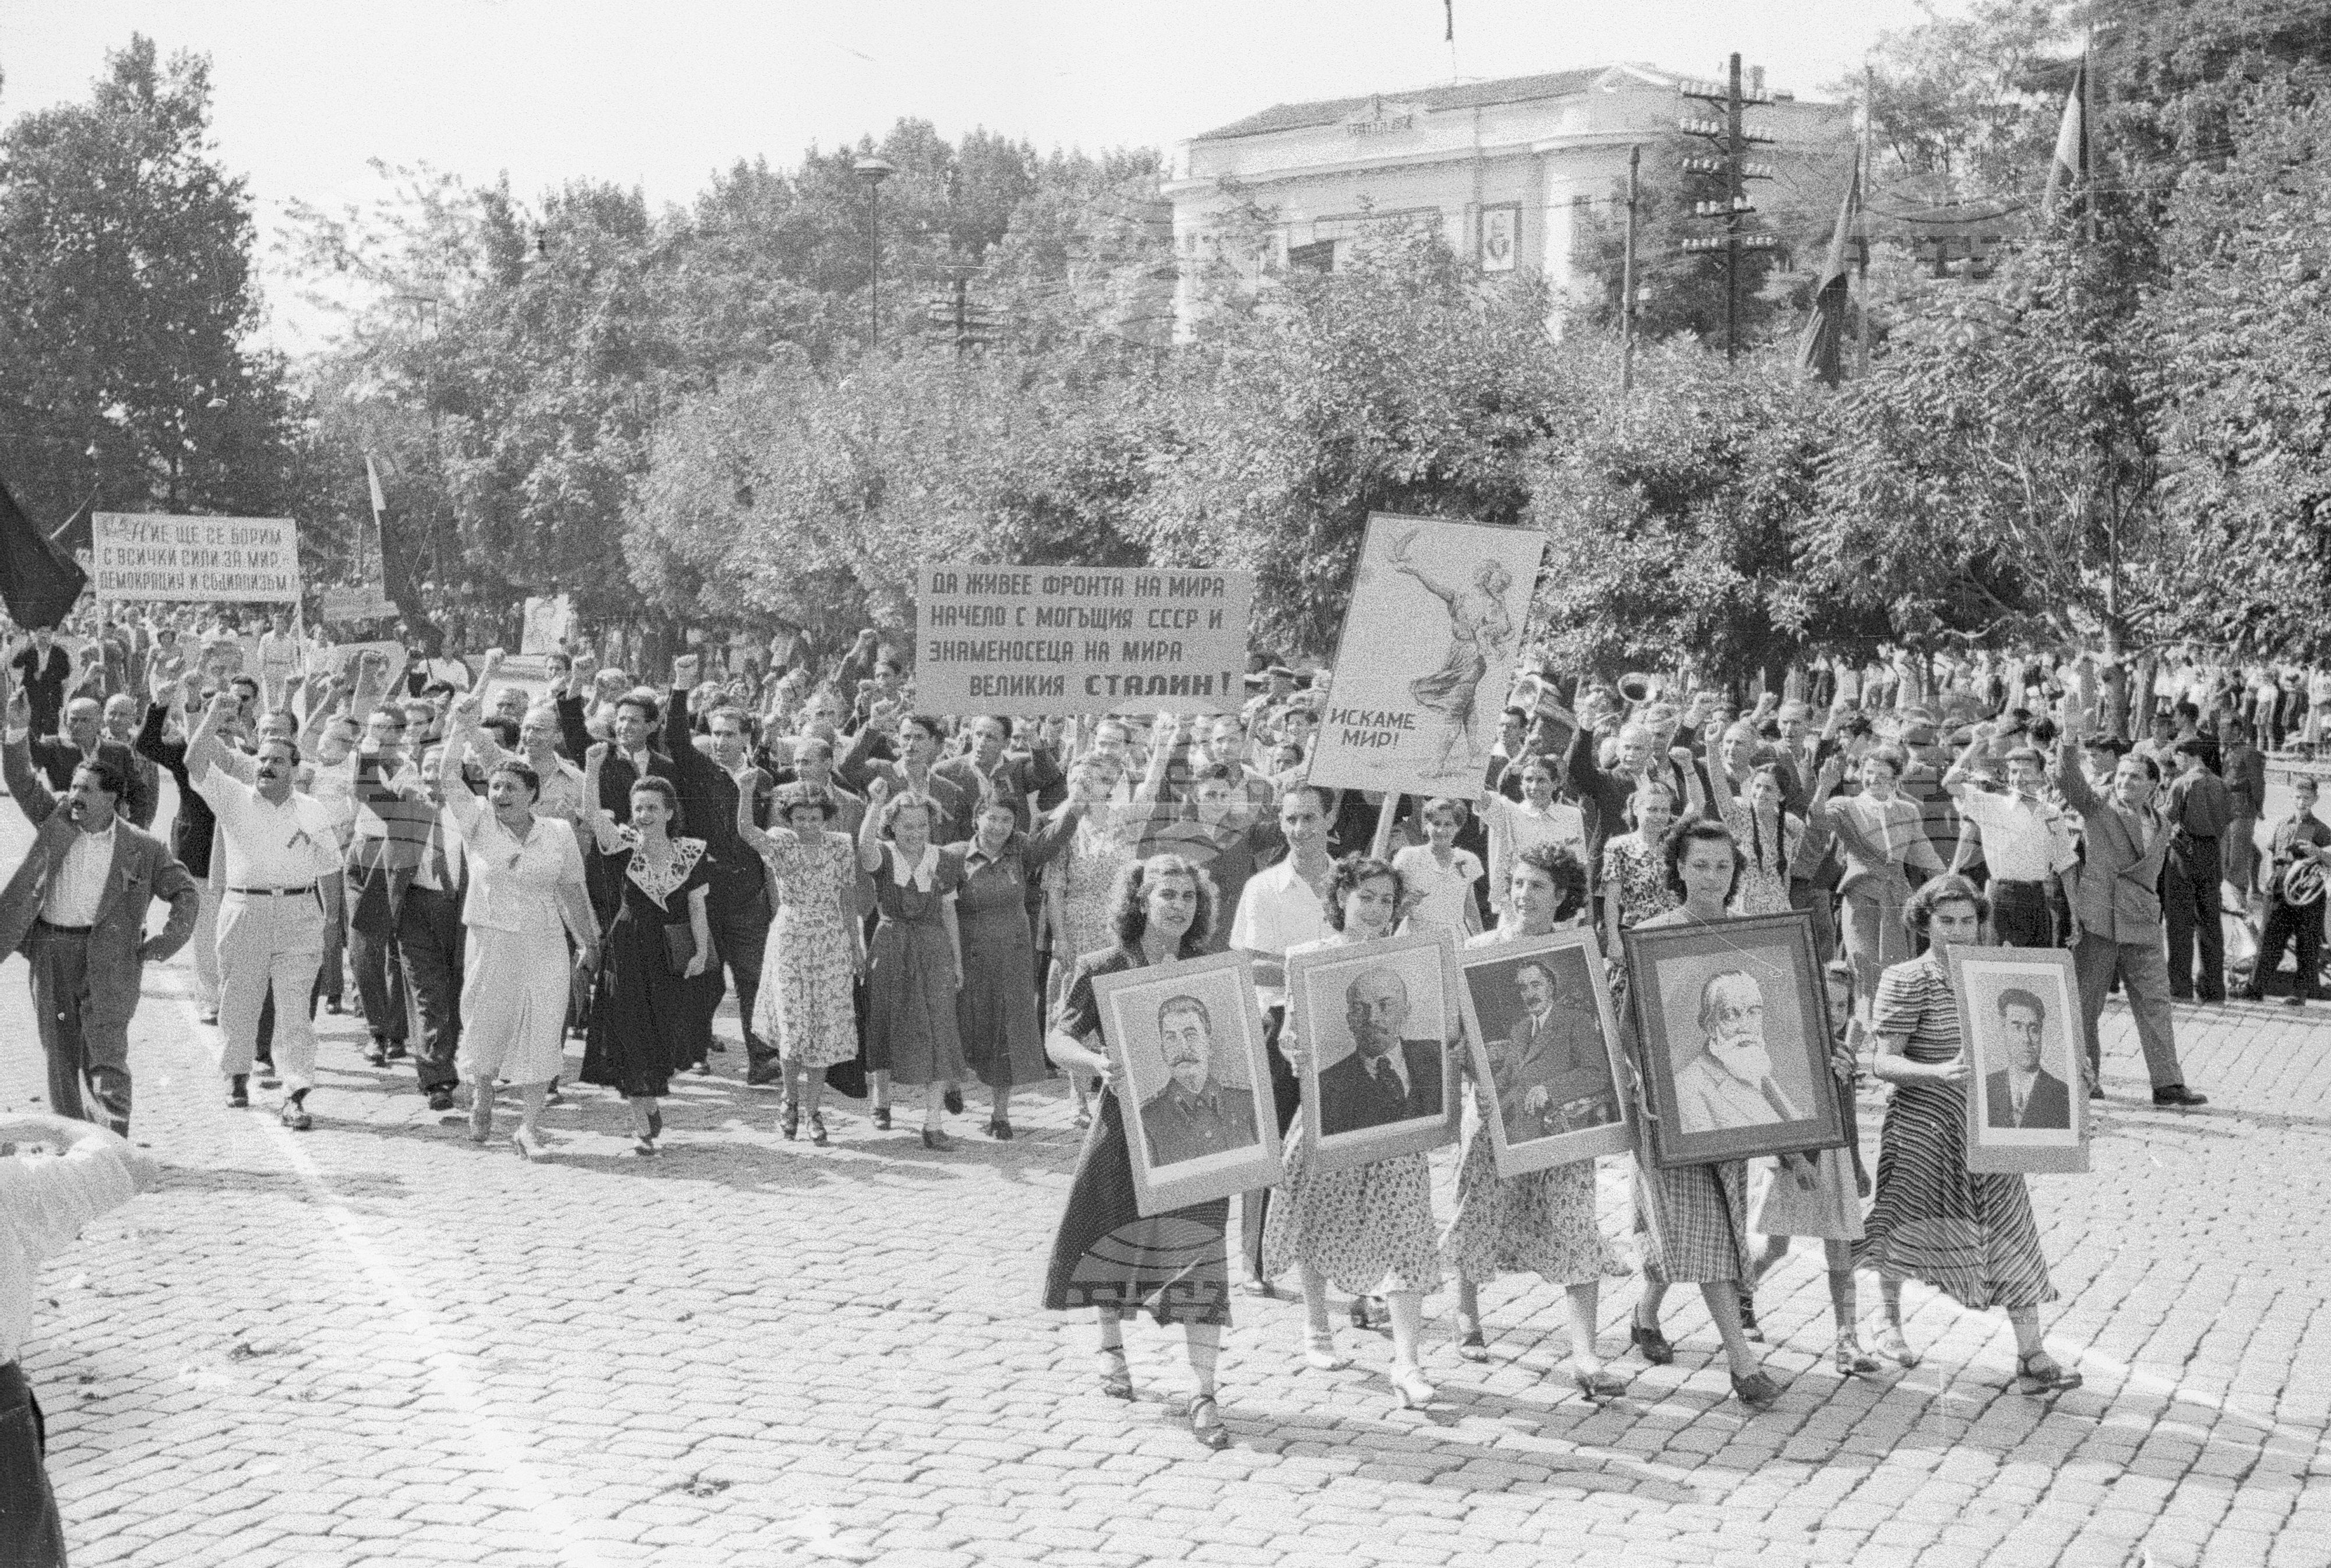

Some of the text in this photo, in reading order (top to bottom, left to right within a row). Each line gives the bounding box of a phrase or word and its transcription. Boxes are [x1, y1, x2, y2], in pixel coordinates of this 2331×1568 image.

[176, 525, 199, 544] ЩЕ
[207, 527, 224, 545] СЕ
[233, 527, 281, 545] БОРИМ
[104, 548, 111, 565] С
[118, 548, 177, 566] ВСИЧКИ
[181, 549, 218, 567] СИЛИ
[224, 551, 241, 568] ЗА
[100, 571, 184, 590] ДЕМОКРАЦИЯ
[190, 574, 197, 590] И
[932, 572, 1224, 597] ДА ЖИВЕЕ ФРОНТА НА МИРА
[931, 605, 1223, 631] НАЧЕЛО С МОГЪЩИЯ СССР И
[929, 641, 1182, 663] ЗНАМЕНОСЕЦА НА МИРА
[970, 671, 1231, 697] ВЕЛИКИЯ СТАЛИН!
[1330, 708, 1416, 731] ИСКАМЕ
[1340, 728, 1398, 749] МИР!
